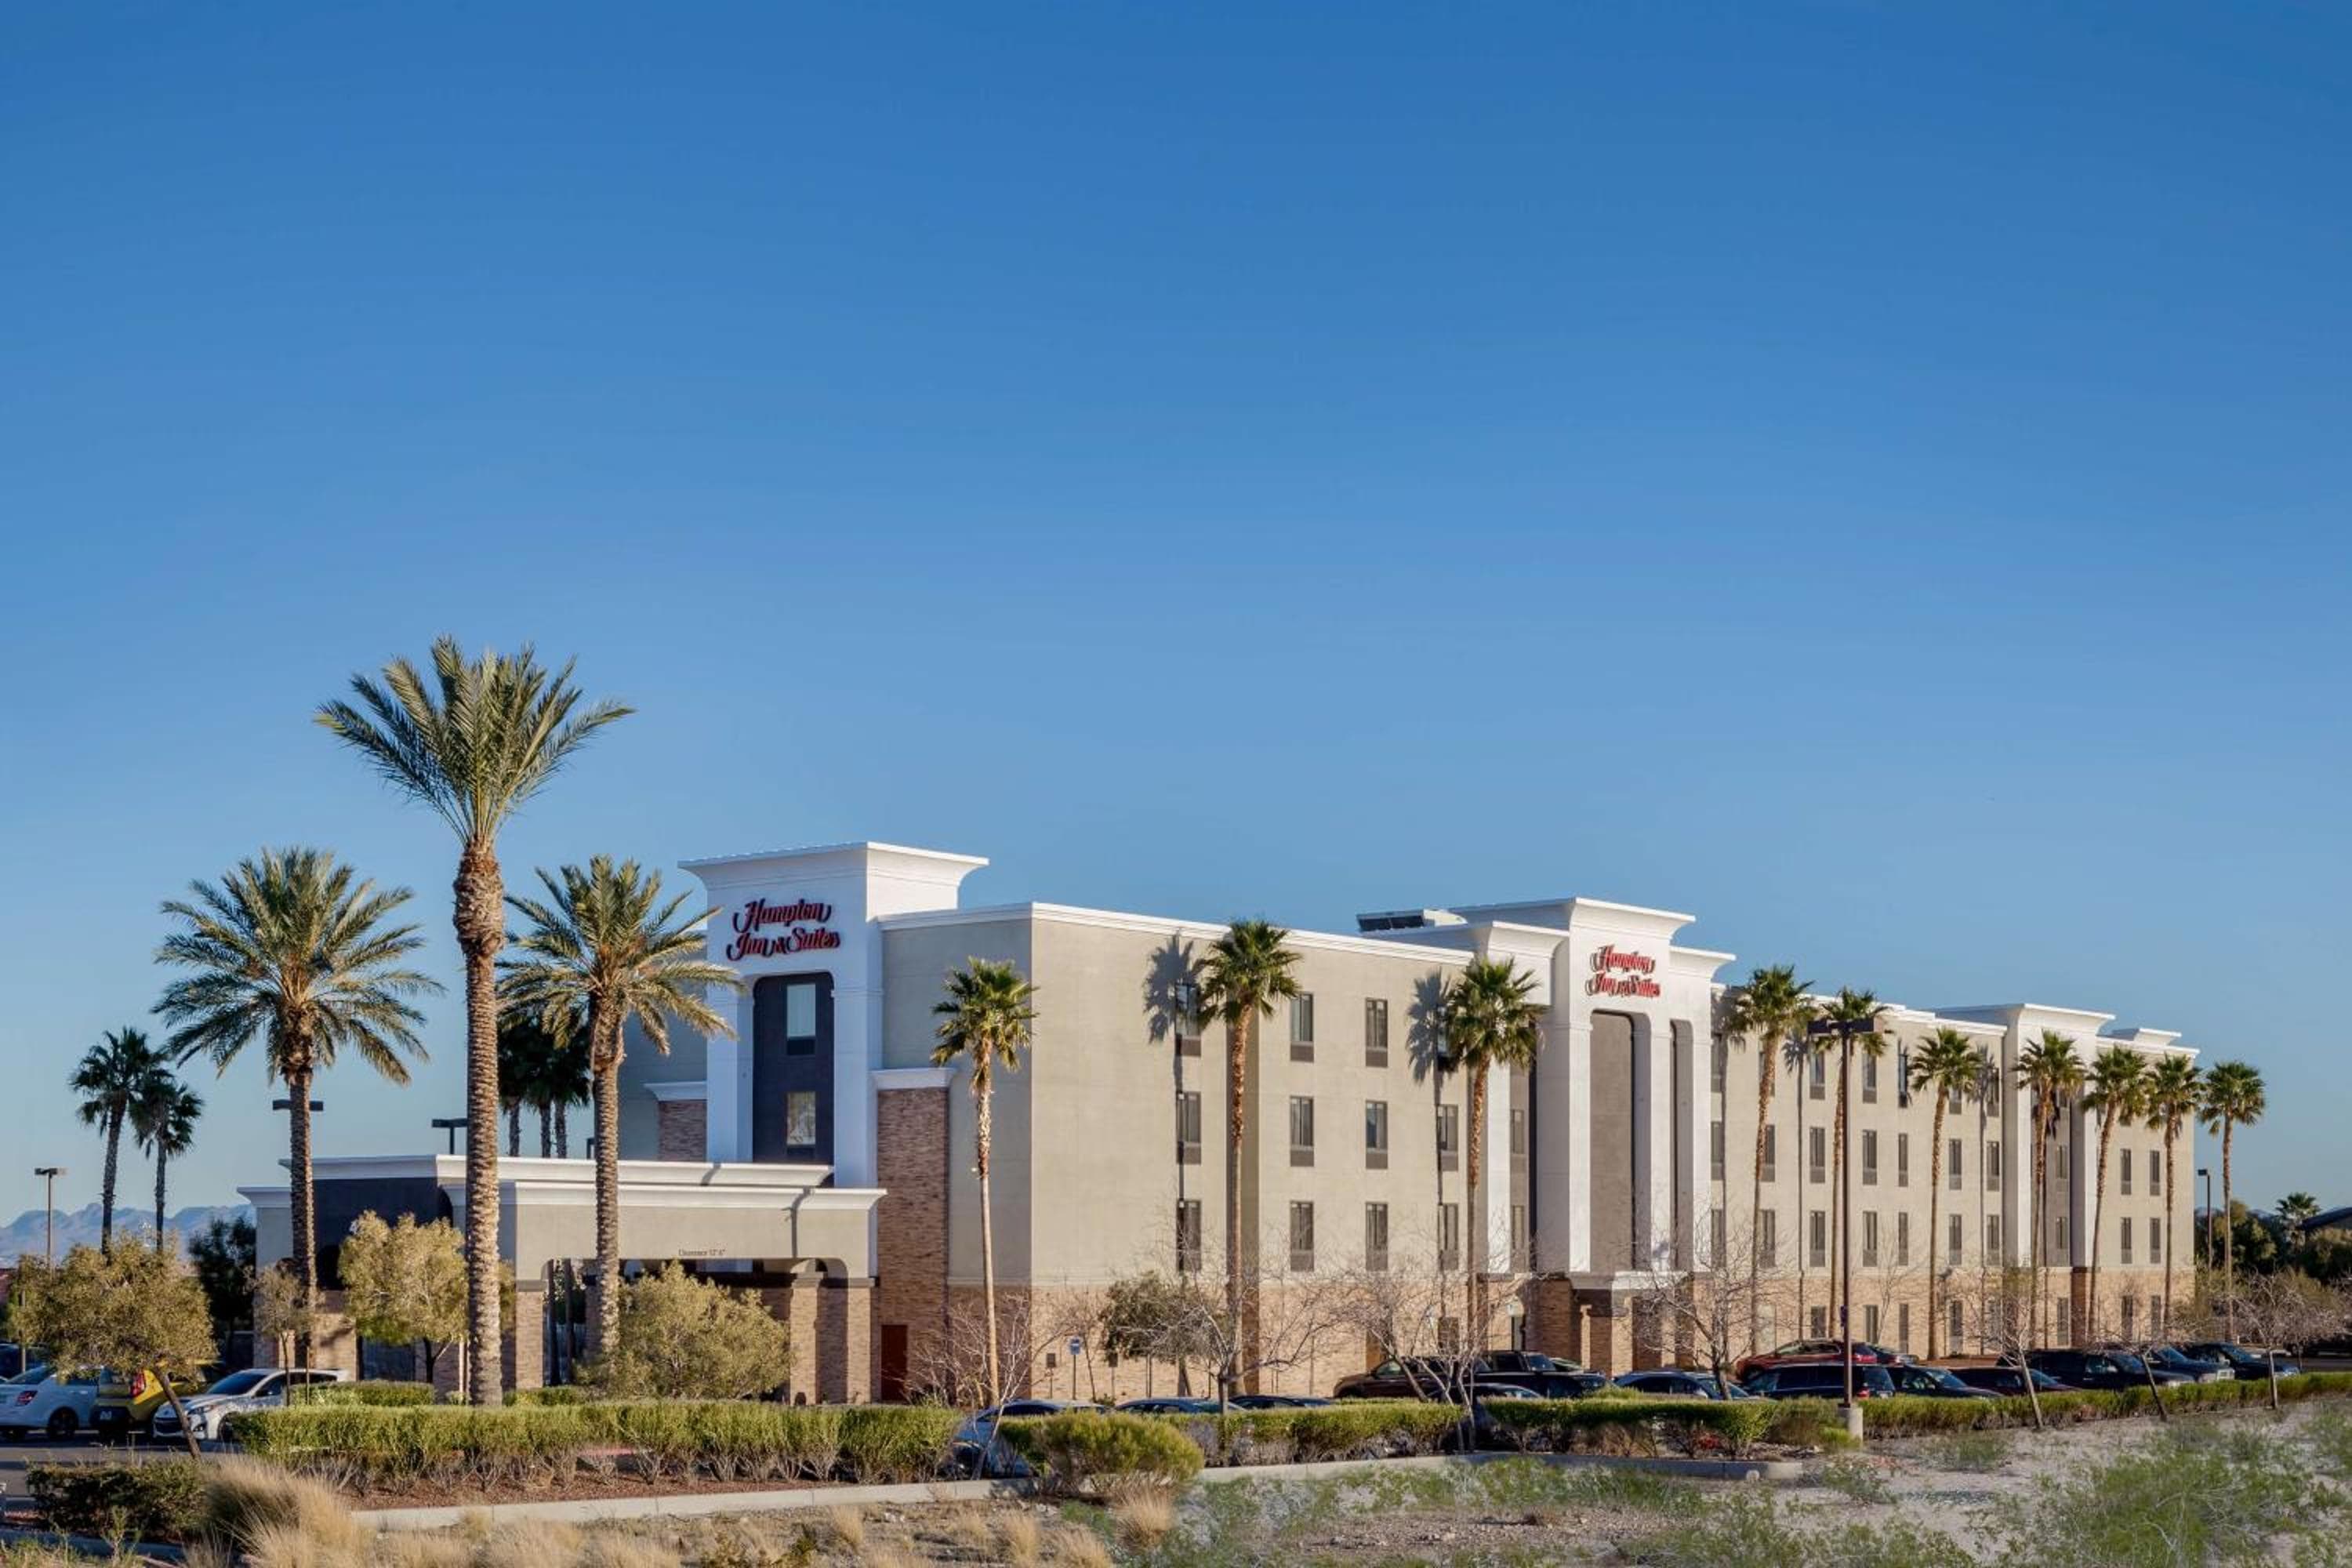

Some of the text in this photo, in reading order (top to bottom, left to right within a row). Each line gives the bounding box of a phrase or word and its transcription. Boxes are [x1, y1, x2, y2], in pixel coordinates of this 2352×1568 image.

[732, 898, 832, 933] Hampton
[726, 932, 776, 960] Inn
[786, 927, 840, 953] Suites
[1589, 944, 1655, 975] Hampton
[1584, 972, 1620, 996] Inn
[1628, 975, 1660, 998] Suites
